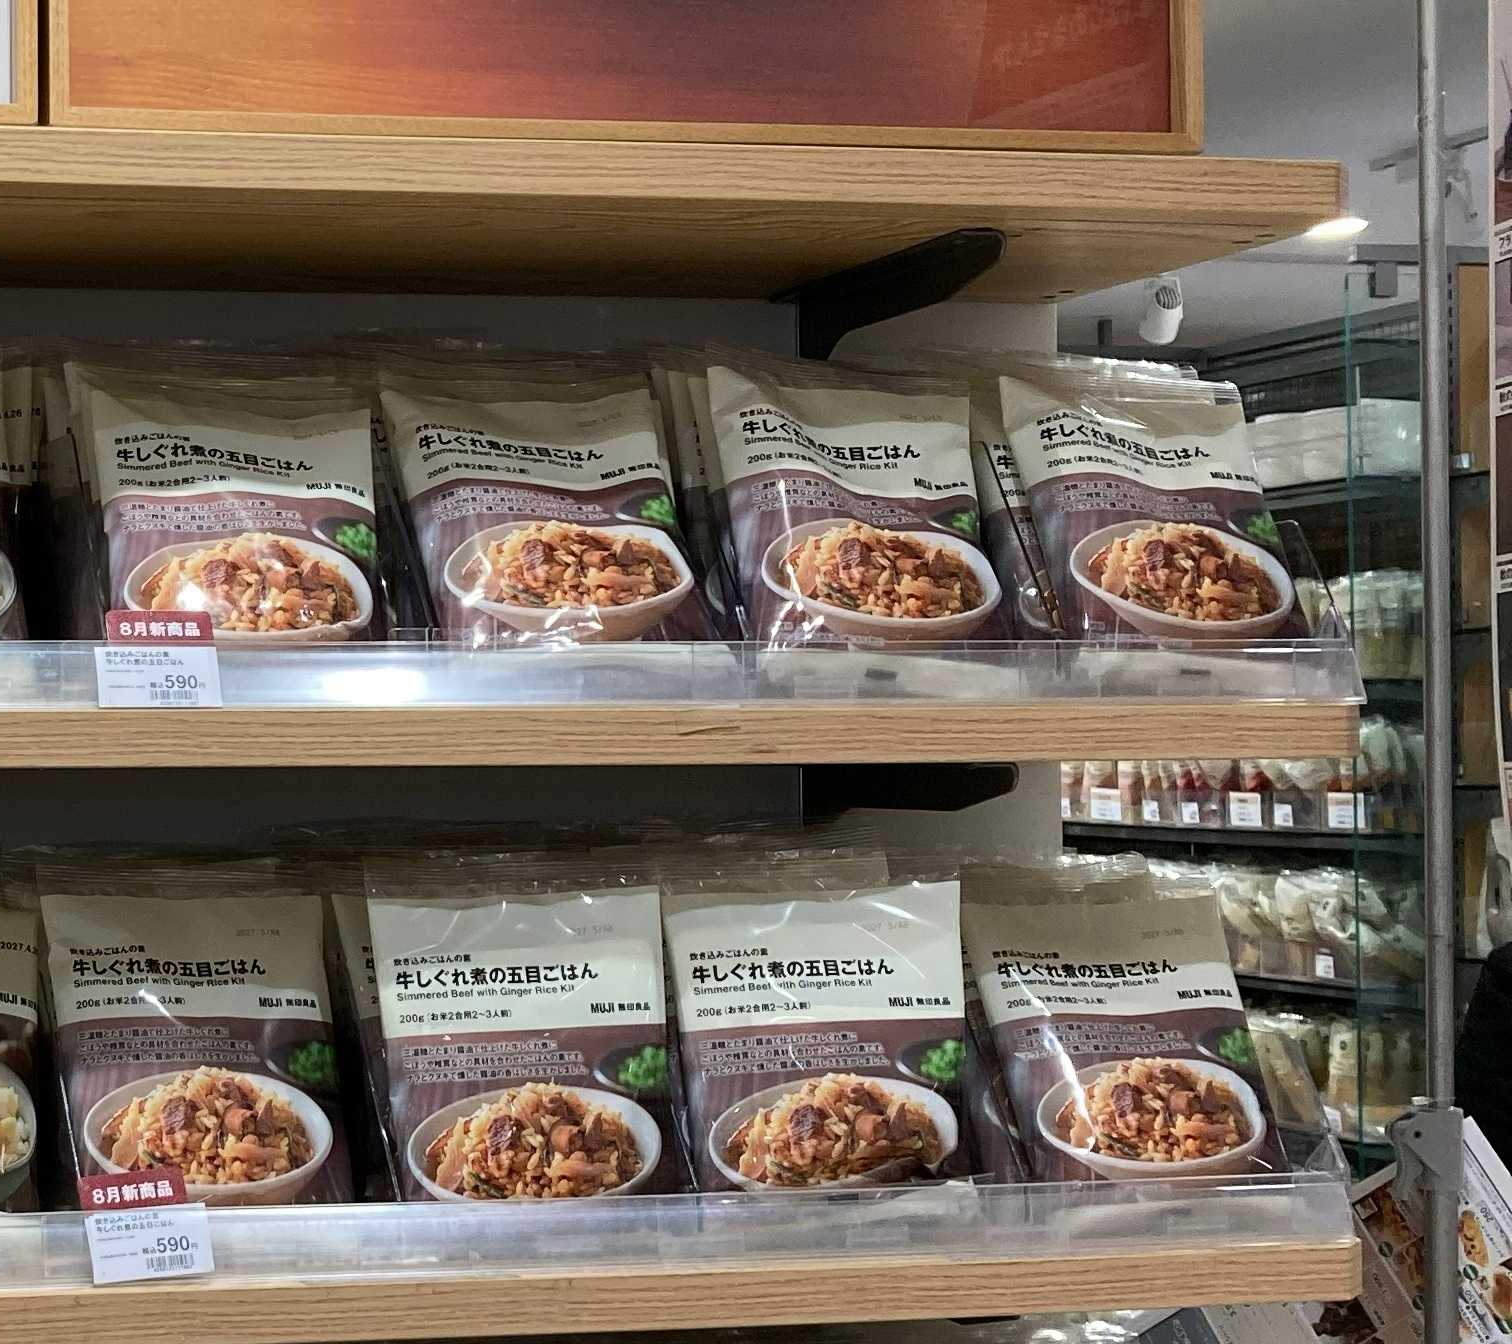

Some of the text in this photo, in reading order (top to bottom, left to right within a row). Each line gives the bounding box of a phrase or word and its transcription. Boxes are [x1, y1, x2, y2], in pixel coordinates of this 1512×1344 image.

[116, 443, 313, 472] 牛しぐれ煮の五目ごはん
[120, 621, 201, 637] 8月新商品
[73, 958, 266, 978] 牛しぐれ煮の五目ごはん
[396, 963, 599, 989] 牛しぐれ煮の五目ごはん
[692, 959, 895, 984] 牛しぐれ煮の五目ごはん
[997, 959, 1177, 979] 牛しぐれ煮の五目ごはん
[73, 976, 245, 988] Simmered Beef with Ginger Rice Kit
[397, 984, 575, 1001] Simmered Beef with Ginger Rice Kit
[259, 997, 283, 1008] MUJI
[591, 1003, 615, 1014] MUJI
[888, 997, 914, 1007] MUJI
[92, 1180, 173, 1204] 8月新商品
